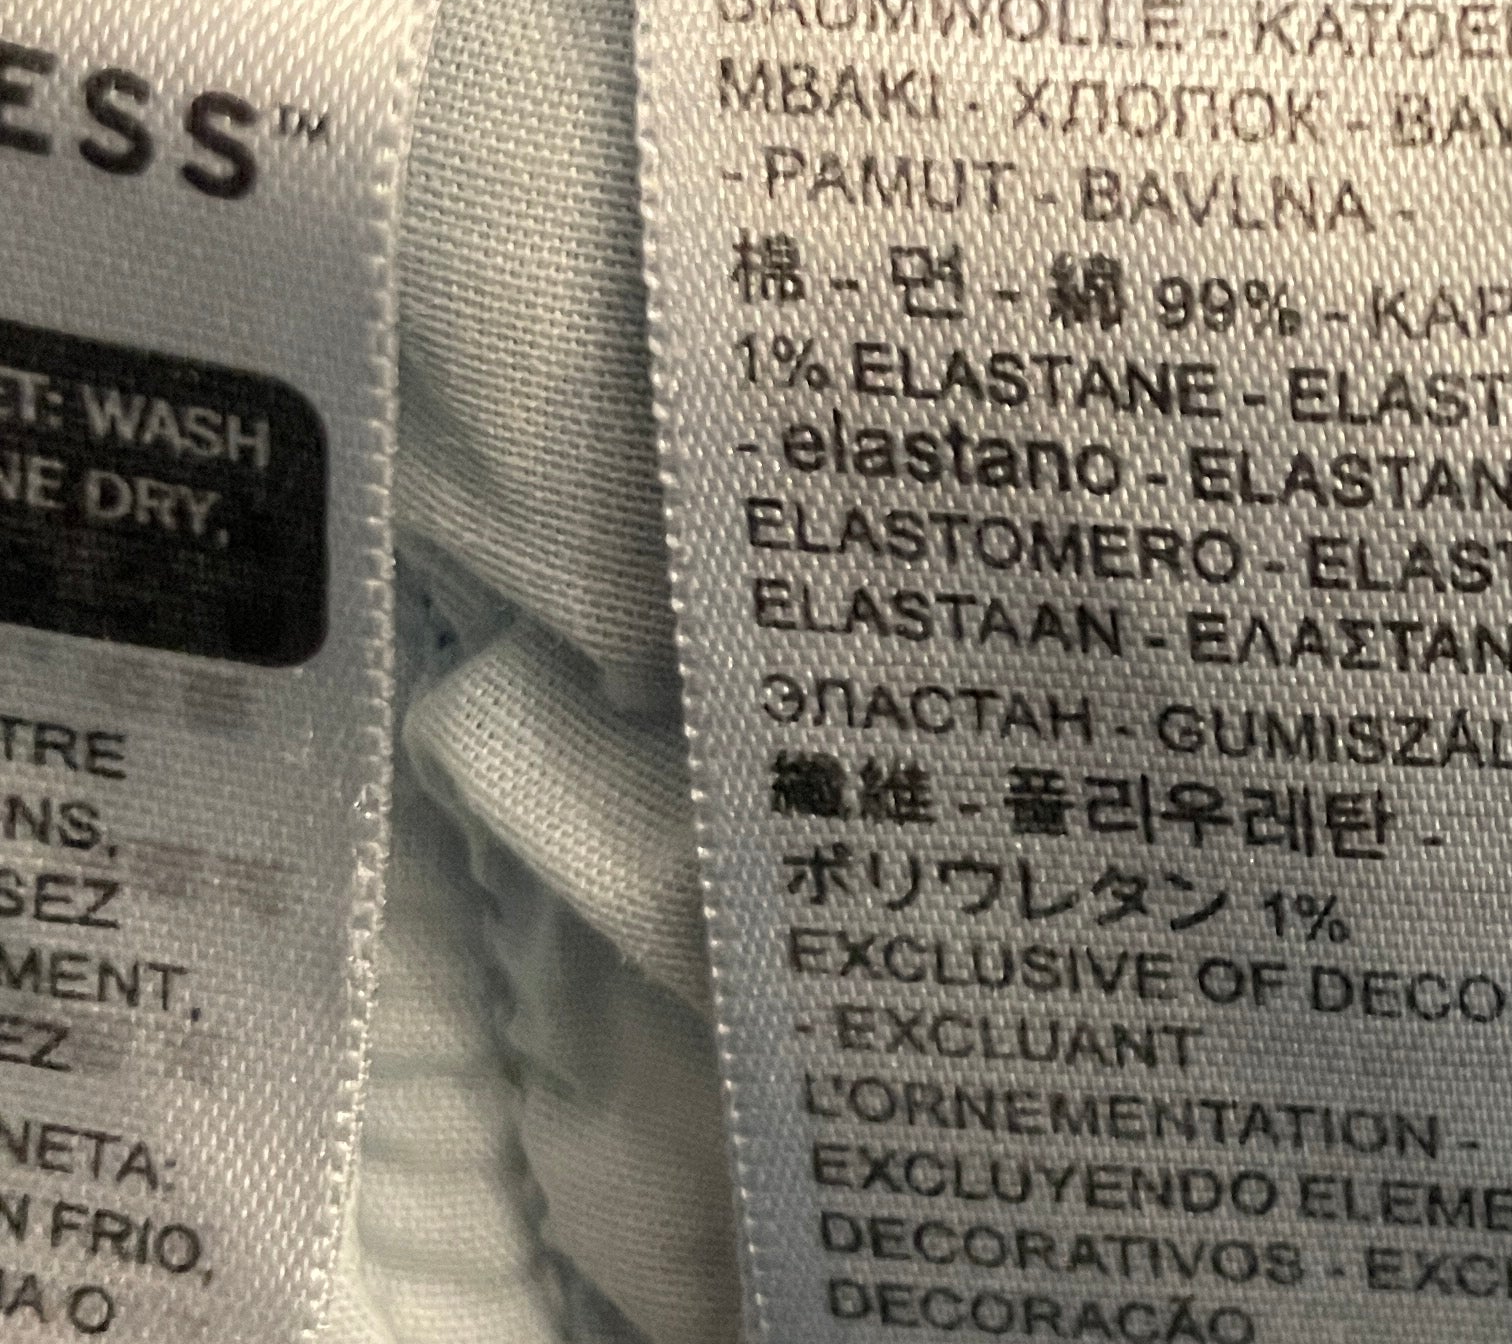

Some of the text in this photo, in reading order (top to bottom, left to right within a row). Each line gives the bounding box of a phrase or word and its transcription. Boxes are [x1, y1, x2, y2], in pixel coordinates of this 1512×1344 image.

[764, 145, 1016, 213] PAMUT
[1083, 164, 1376, 234] BAVLNA
[1155, 275, 1302, 338] 99%
[735, 332, 831, 392] 1%
[853, 340, 1223, 420] ELASTANE
[83, 382, 271, 470] WASH
[782, 407, 1122, 497] elastano
[747, 496, 1243, 584] ELASTOMERO
[754, 576, 1124, 658] ELASTAAN
[1263, 889, 1350, 944] 1%
[788, 925, 1177, 1000] EXCLUSIVE
[1197, 956, 1288, 1007] OF
[837, 1003, 1203, 1073] EXCLUANT
[804, 1071, 1438, 1158] L'ORNEMENTATION
[811, 1141, 1279, 1217] EXCLUYENDO
[820, 1210, 1306, 1286] DECORATIVOS
[68, 1284, 116, 1335] O
